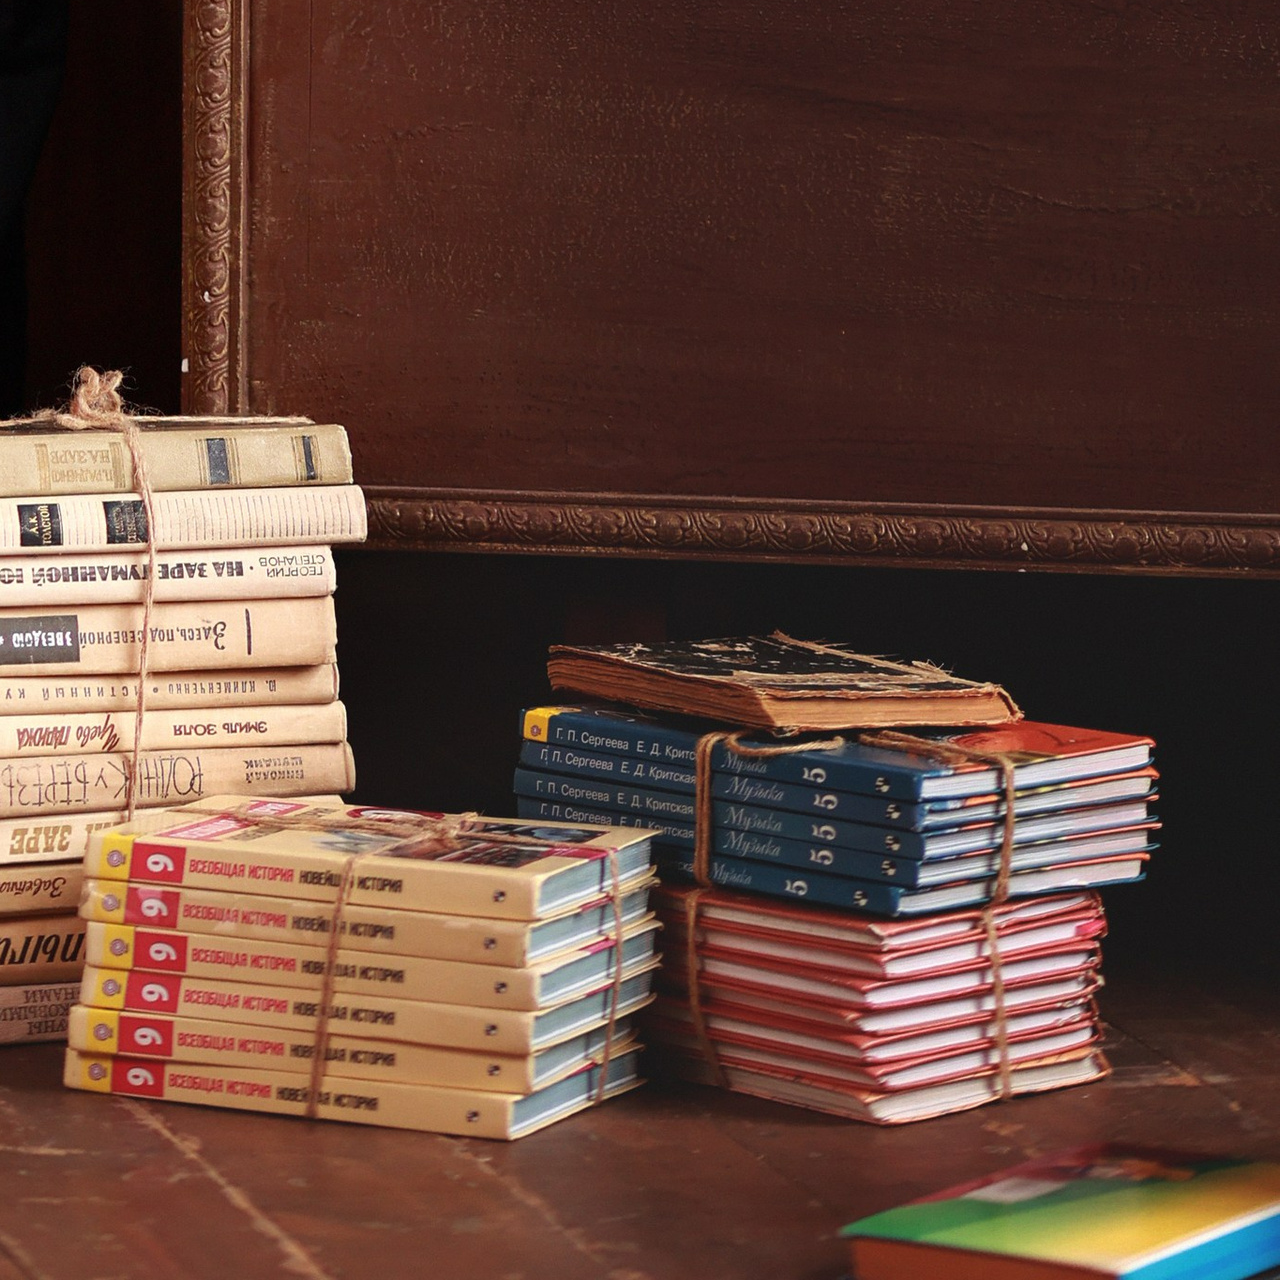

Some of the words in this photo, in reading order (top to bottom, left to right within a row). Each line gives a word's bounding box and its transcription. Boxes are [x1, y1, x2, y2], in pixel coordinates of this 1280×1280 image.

[41, 504, 52, 545] ТОЛСТОЙ
[32, 563, 153, 588] ТУМАННОЙ
[158, 562, 208, 581] ЗАРЕ
[211, 561, 245, 578] НА
[259, 554, 326, 567] СТЕПАНОВ
[266, 565, 324, 578] ГЕОРГИЙ
[12, 630, 73, 648] ЗВЕЗДОЮ
[78, 629, 144, 649] СЕВЕРНОЙ
[168, 679, 256, 694] КЛИМЕНЧЕНКО
[265, 679, 277, 693] Ю.
[75, 714, 121, 751] Чрево
[173, 723, 217, 736] ЗОЛЯ
[222, 721, 268, 735] ЭМИЛЬ
[556, 727, 564, 740] Г.
[567, 729, 579, 743] П.
[580, 731, 629, 750] Сергеева
[636, 740, 647, 753] Е.
[665, 745, 697, 761] Критс
[720, 750, 767, 774] Музыка
[802, 767, 827, 783] 5
[552, 750, 563, 763] П.
[565, 752, 614, 771] Сергеева
[621, 761, 631, 775] Е.
[648, 766, 697, 785] Критская
[724, 775, 784, 801] Музыка
[813, 793, 838, 810] 5
[536, 780, 544, 792] Г.
[547, 781, 559, 795] П.
[560, 784, 610, 802] Сергеева
[617, 792, 628, 805] Е.
[645, 796, 694, 815] Критская
[723, 806, 783, 832] Музыка
[811, 823, 837, 841] 5
[8, 824, 73, 855] ЗАРЕ
[540, 803, 548, 815] Г.
[551, 804, 562, 818] П.
[564, 807, 613, 826] Сергеева
[722, 830, 781, 857] Музыка
[809, 848, 834, 866] 5
[146, 853, 175, 873] 9
[189, 859, 246, 879] ВСЕОБЩАЯ
[247, 863, 295, 884] ИСТОРИЯ
[357, 875, 404, 894] ИСТОРИЯ
[712, 861, 752, 885] Музыка
[785, 879, 808, 896] 5
[140, 897, 169, 918] 9
[182, 903, 240, 924] ВСЕОБЩАЯ
[240, 908, 287, 929] ИСТОРИЯ
[349, 921, 395, 940] ИСТОРИЯ
[148, 941, 178, 962] 9
[191, 947, 248, 968] ВСЕОБЩАЯ
[249, 952, 297, 973] ИСТОРИЯ
[358, 964, 405, 984] ИСТОРИЯ
[23, 989, 82, 1003] НАМИ
[140, 982, 170, 1003] 9
[183, 988, 240, 1009] ВСЕОБЩАЯ
[241, 994, 289, 1014] ИСТОРИЯ
[349, 1006, 396, 1026] ИСТОРИЯ
[133, 1026, 163, 1047] 9
[176, 1031, 235, 1052] ВСЕОБЩАЯ
[236, 1037, 286, 1057] ИСТОРИЯ
[349, 1048, 397, 1068] ИСТОРИЯ
[126, 1066, 155, 1088] 9
[168, 1072, 224, 1093] ВСЕОБЩАЯ
[225, 1078, 273, 1099] ИСТОРИЯ
[332, 1090, 379, 1111] ИСТОРИЯ
